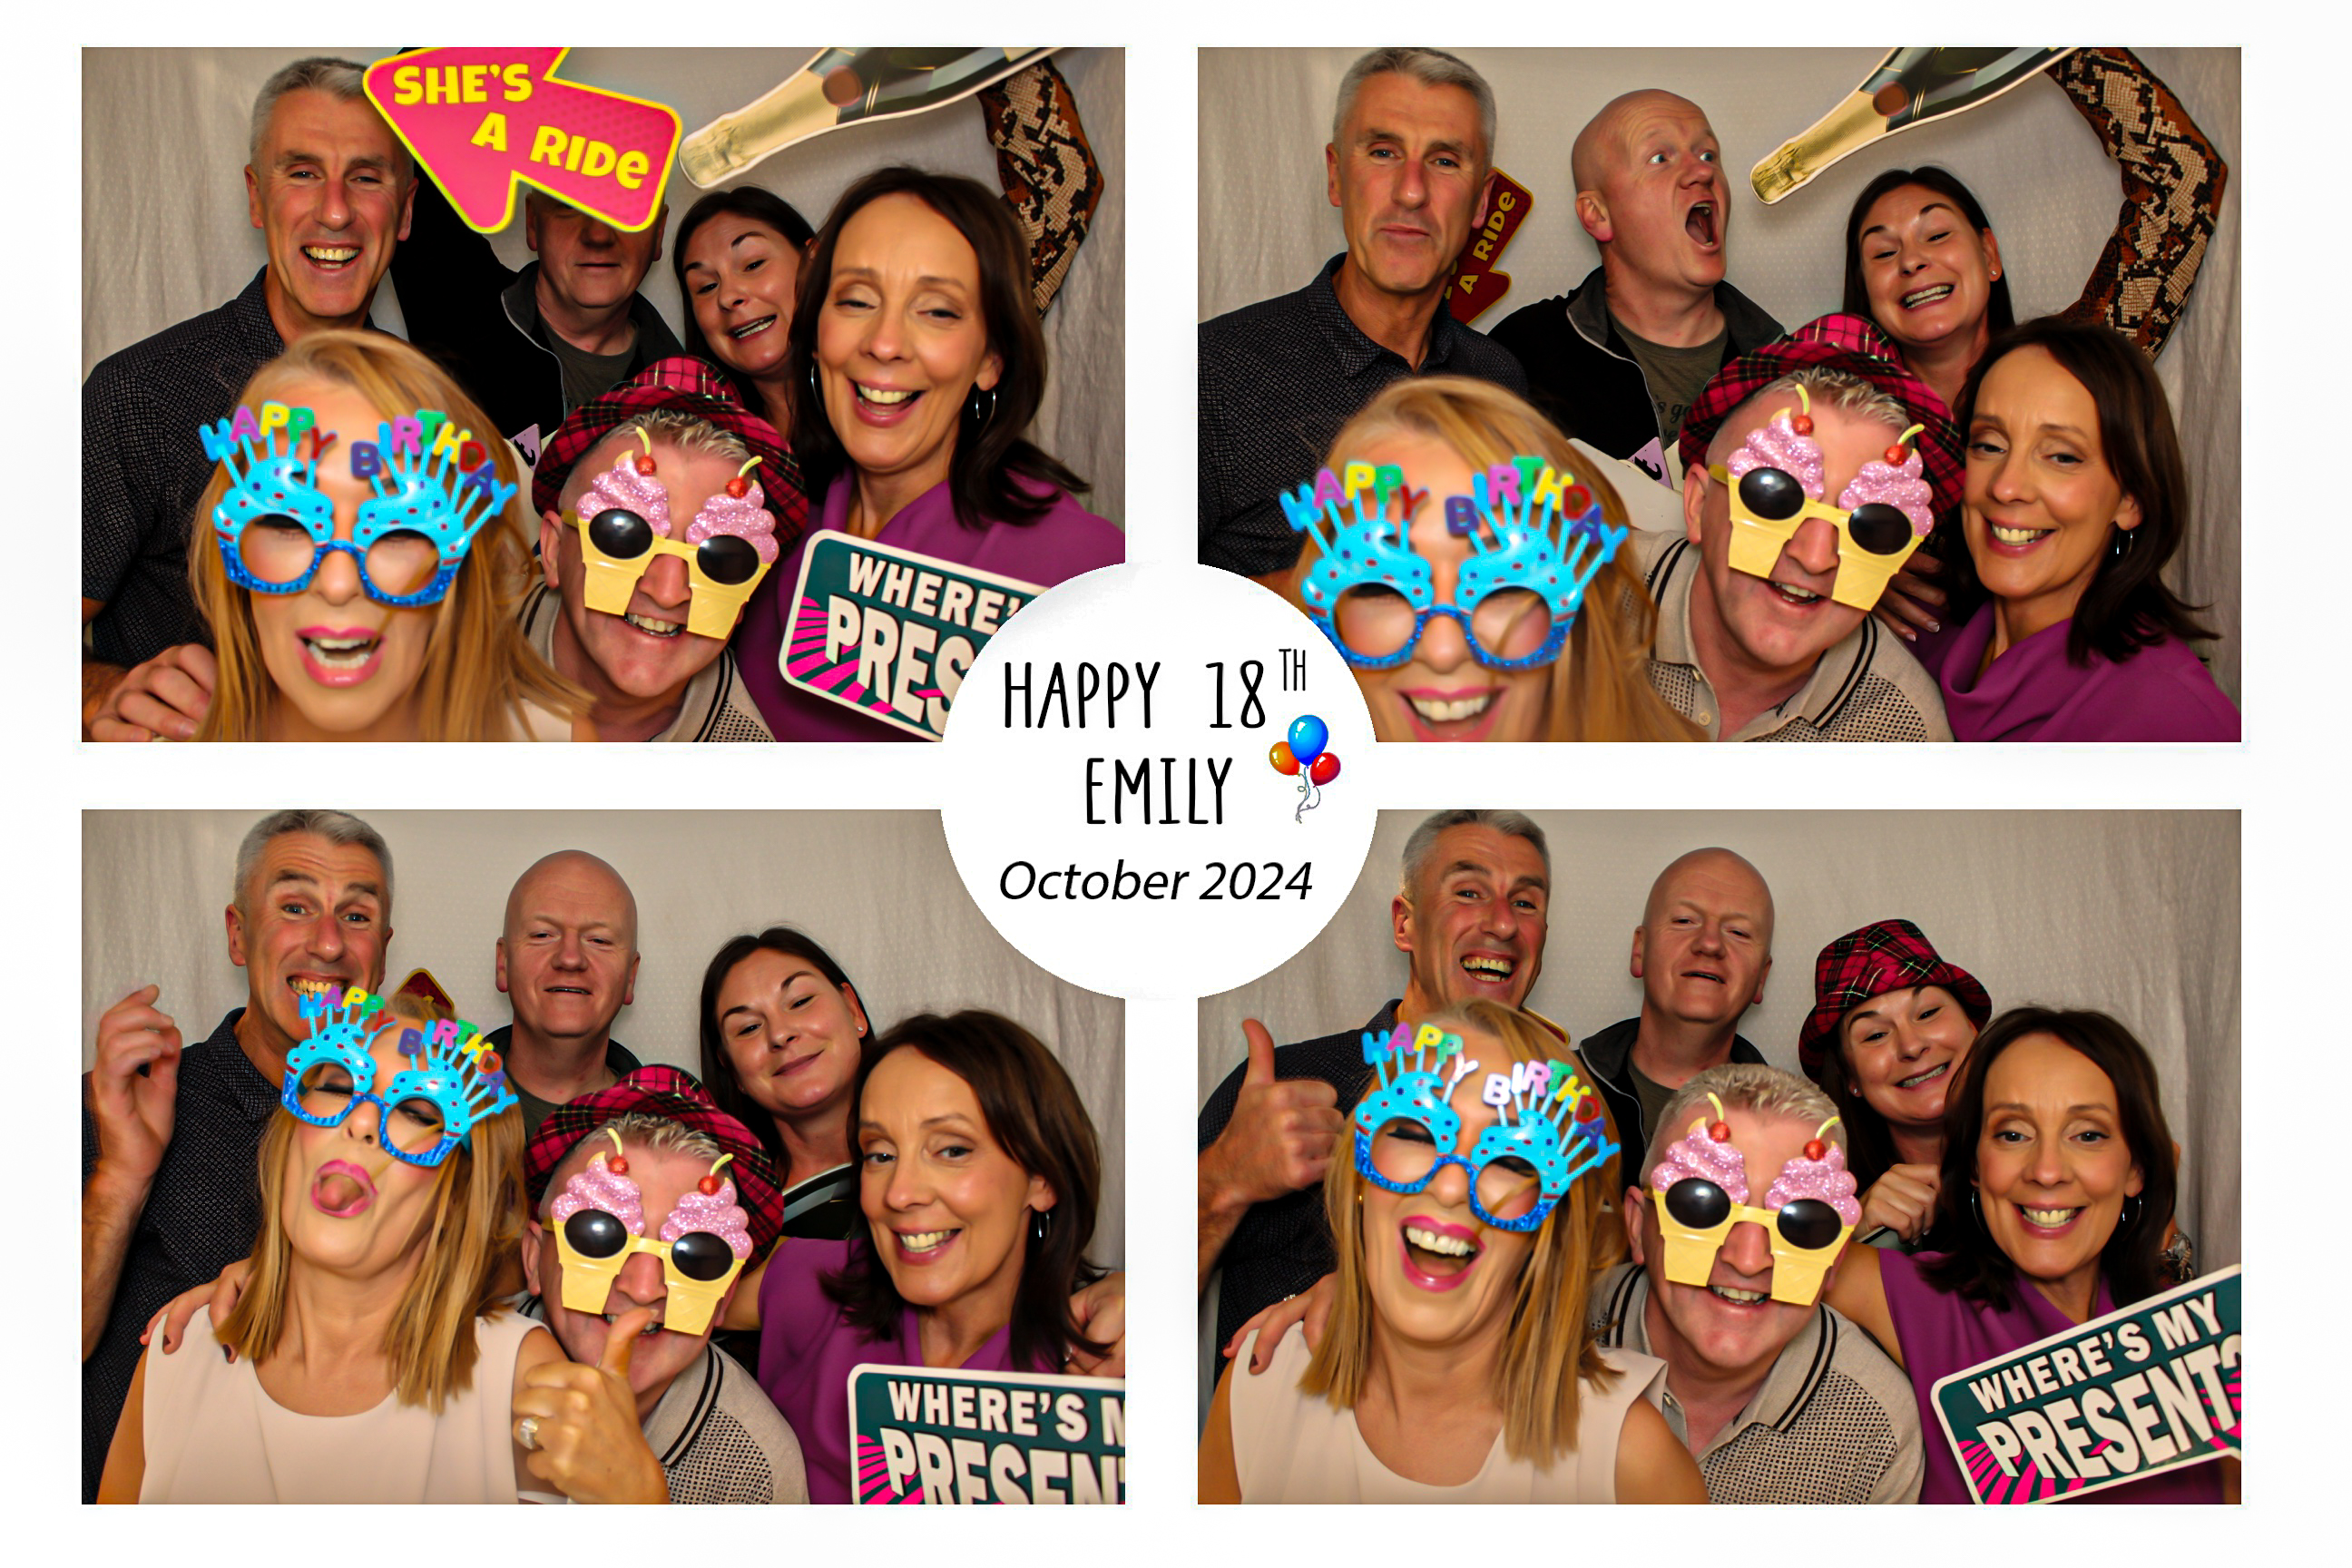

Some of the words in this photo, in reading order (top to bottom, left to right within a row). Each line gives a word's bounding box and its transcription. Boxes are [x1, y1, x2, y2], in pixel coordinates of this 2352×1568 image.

[393, 64, 533, 105] SHE'S
[470, 112, 507, 152] A
[1458, 274, 1479, 295] A
[199, 400, 338, 462] HAPPY
[350, 409, 518, 515] BIRTHDAY
[1279, 461, 1430, 532] HAPPY
[1444, 456, 1628, 564] BIRTHDAY
[299, 985, 397, 1032] HAPPY
[397, 1018, 519, 1114] BIRTHDAY
[1362, 1022, 1479, 1083] HAPPY
[1482, 1059, 1621, 1168] BIRTHDAY
[1968, 1323, 2151, 1414] WHERE'S
[2151, 1292, 2222, 1351] MY
[887, 1380, 1088, 1442] WHERE'S
[879, 1427, 1125, 1504] PRESEN
